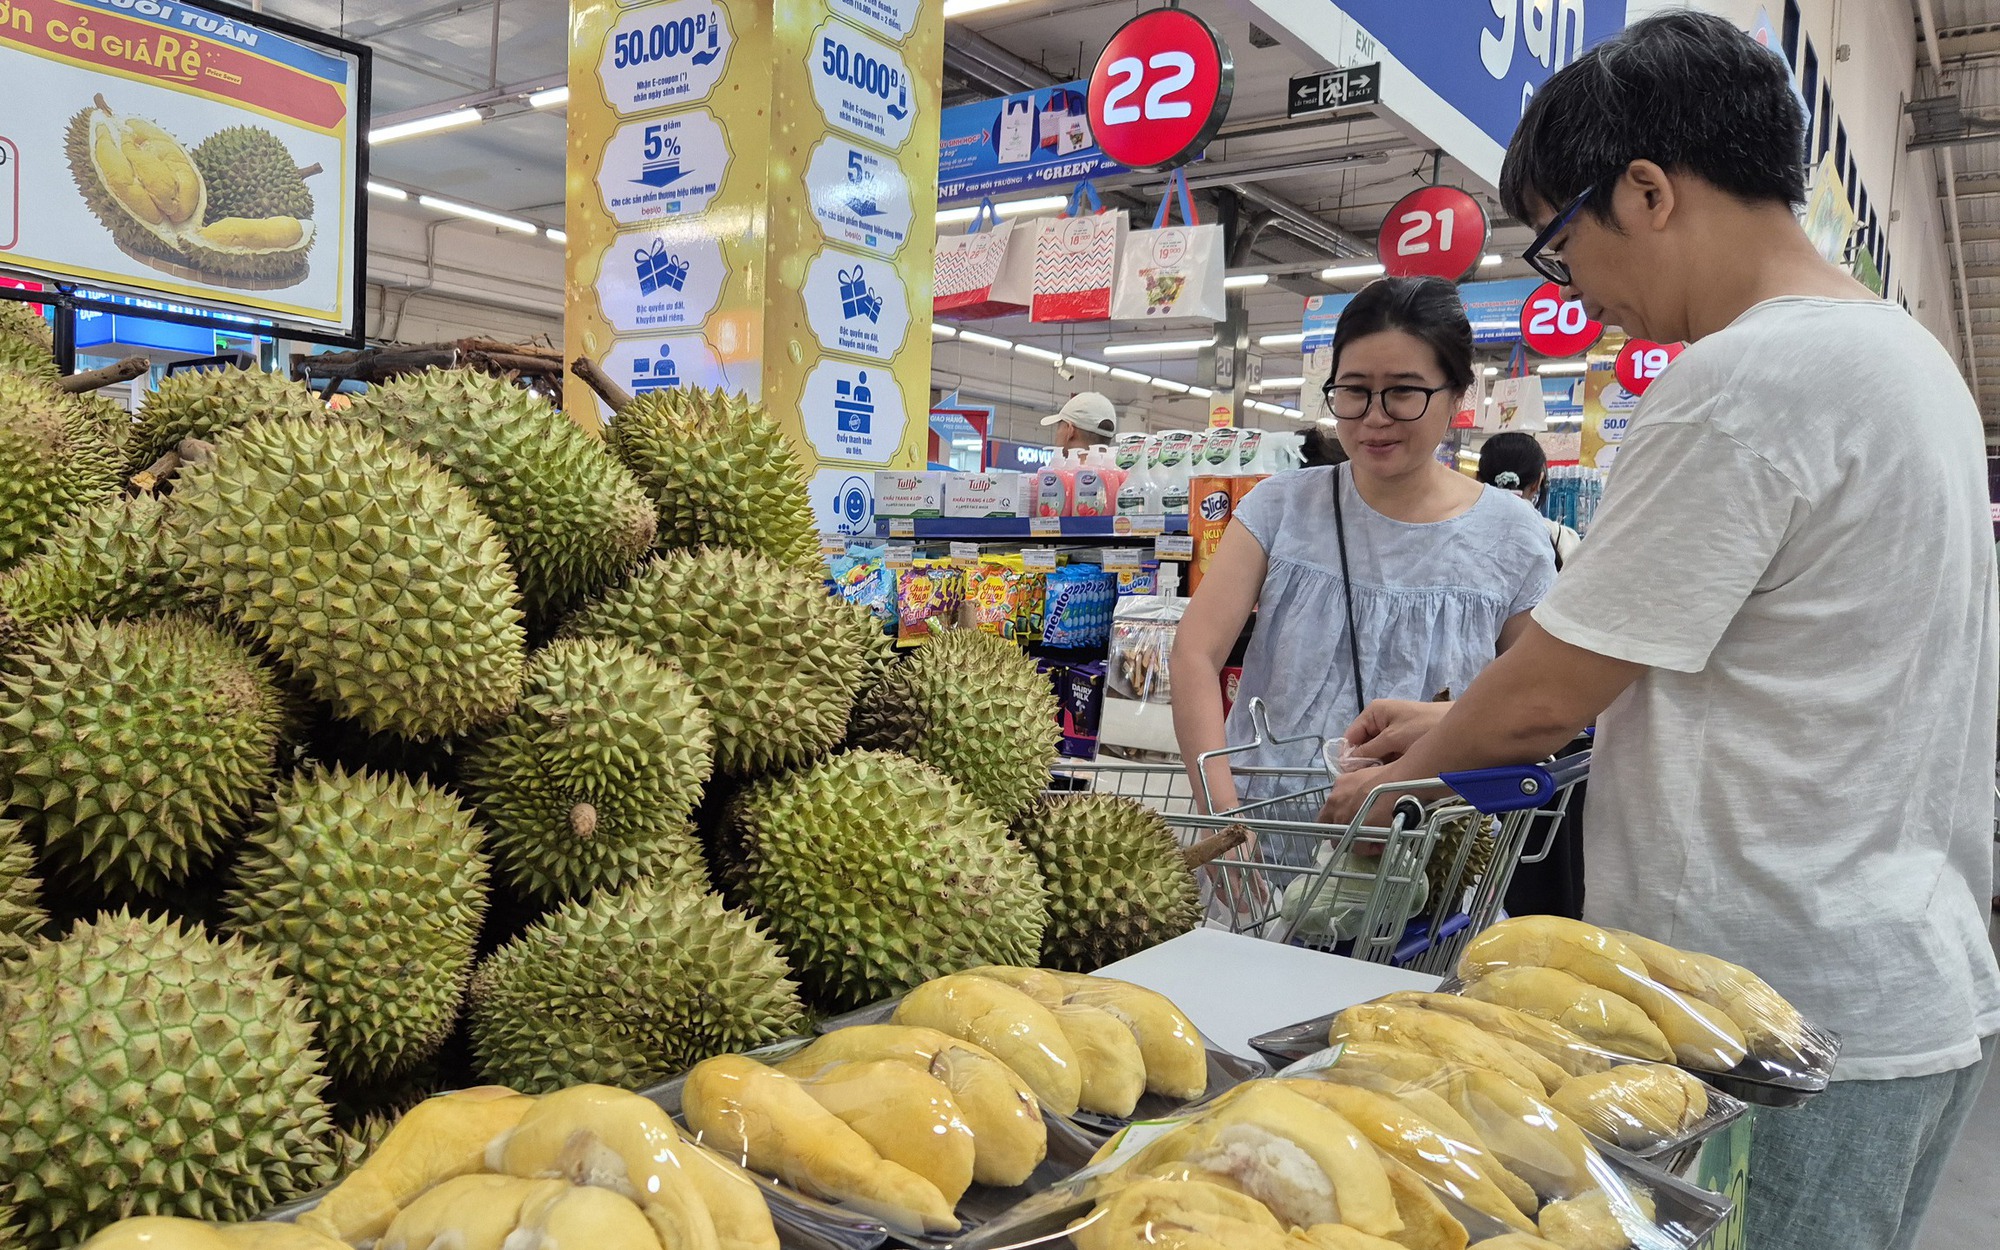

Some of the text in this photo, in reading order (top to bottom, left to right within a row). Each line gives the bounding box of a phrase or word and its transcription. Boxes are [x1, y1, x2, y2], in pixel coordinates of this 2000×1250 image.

[46, 17, 96, 50] cả
[181, 11, 258, 47] TUẦN
[1355, 29, 1375, 60] EXIT
[652, 75, 679, 88] E-coupon
[663, 86, 675, 96] sinh
[1103, 51, 1196, 126] 22
[1348, 87, 1372, 97] EXIT
[966, 183, 979, 192] CHO
[1397, 207, 1455, 257] 21
[1529, 299, 1587, 335] 20
[1217, 356, 1232, 377] 20
[1246, 363, 1261, 383] 19
[1631, 348, 1669, 379] 19
[1018, 447, 1038, 465] DỊCH
[1201, 495, 1228, 519] Slide
[982, 583, 1005, 592] Chupa
[1044, 585, 1074, 641] mentos
[1071, 683, 1092, 695] DAIRY
[1073, 691, 1090, 702] MILK
